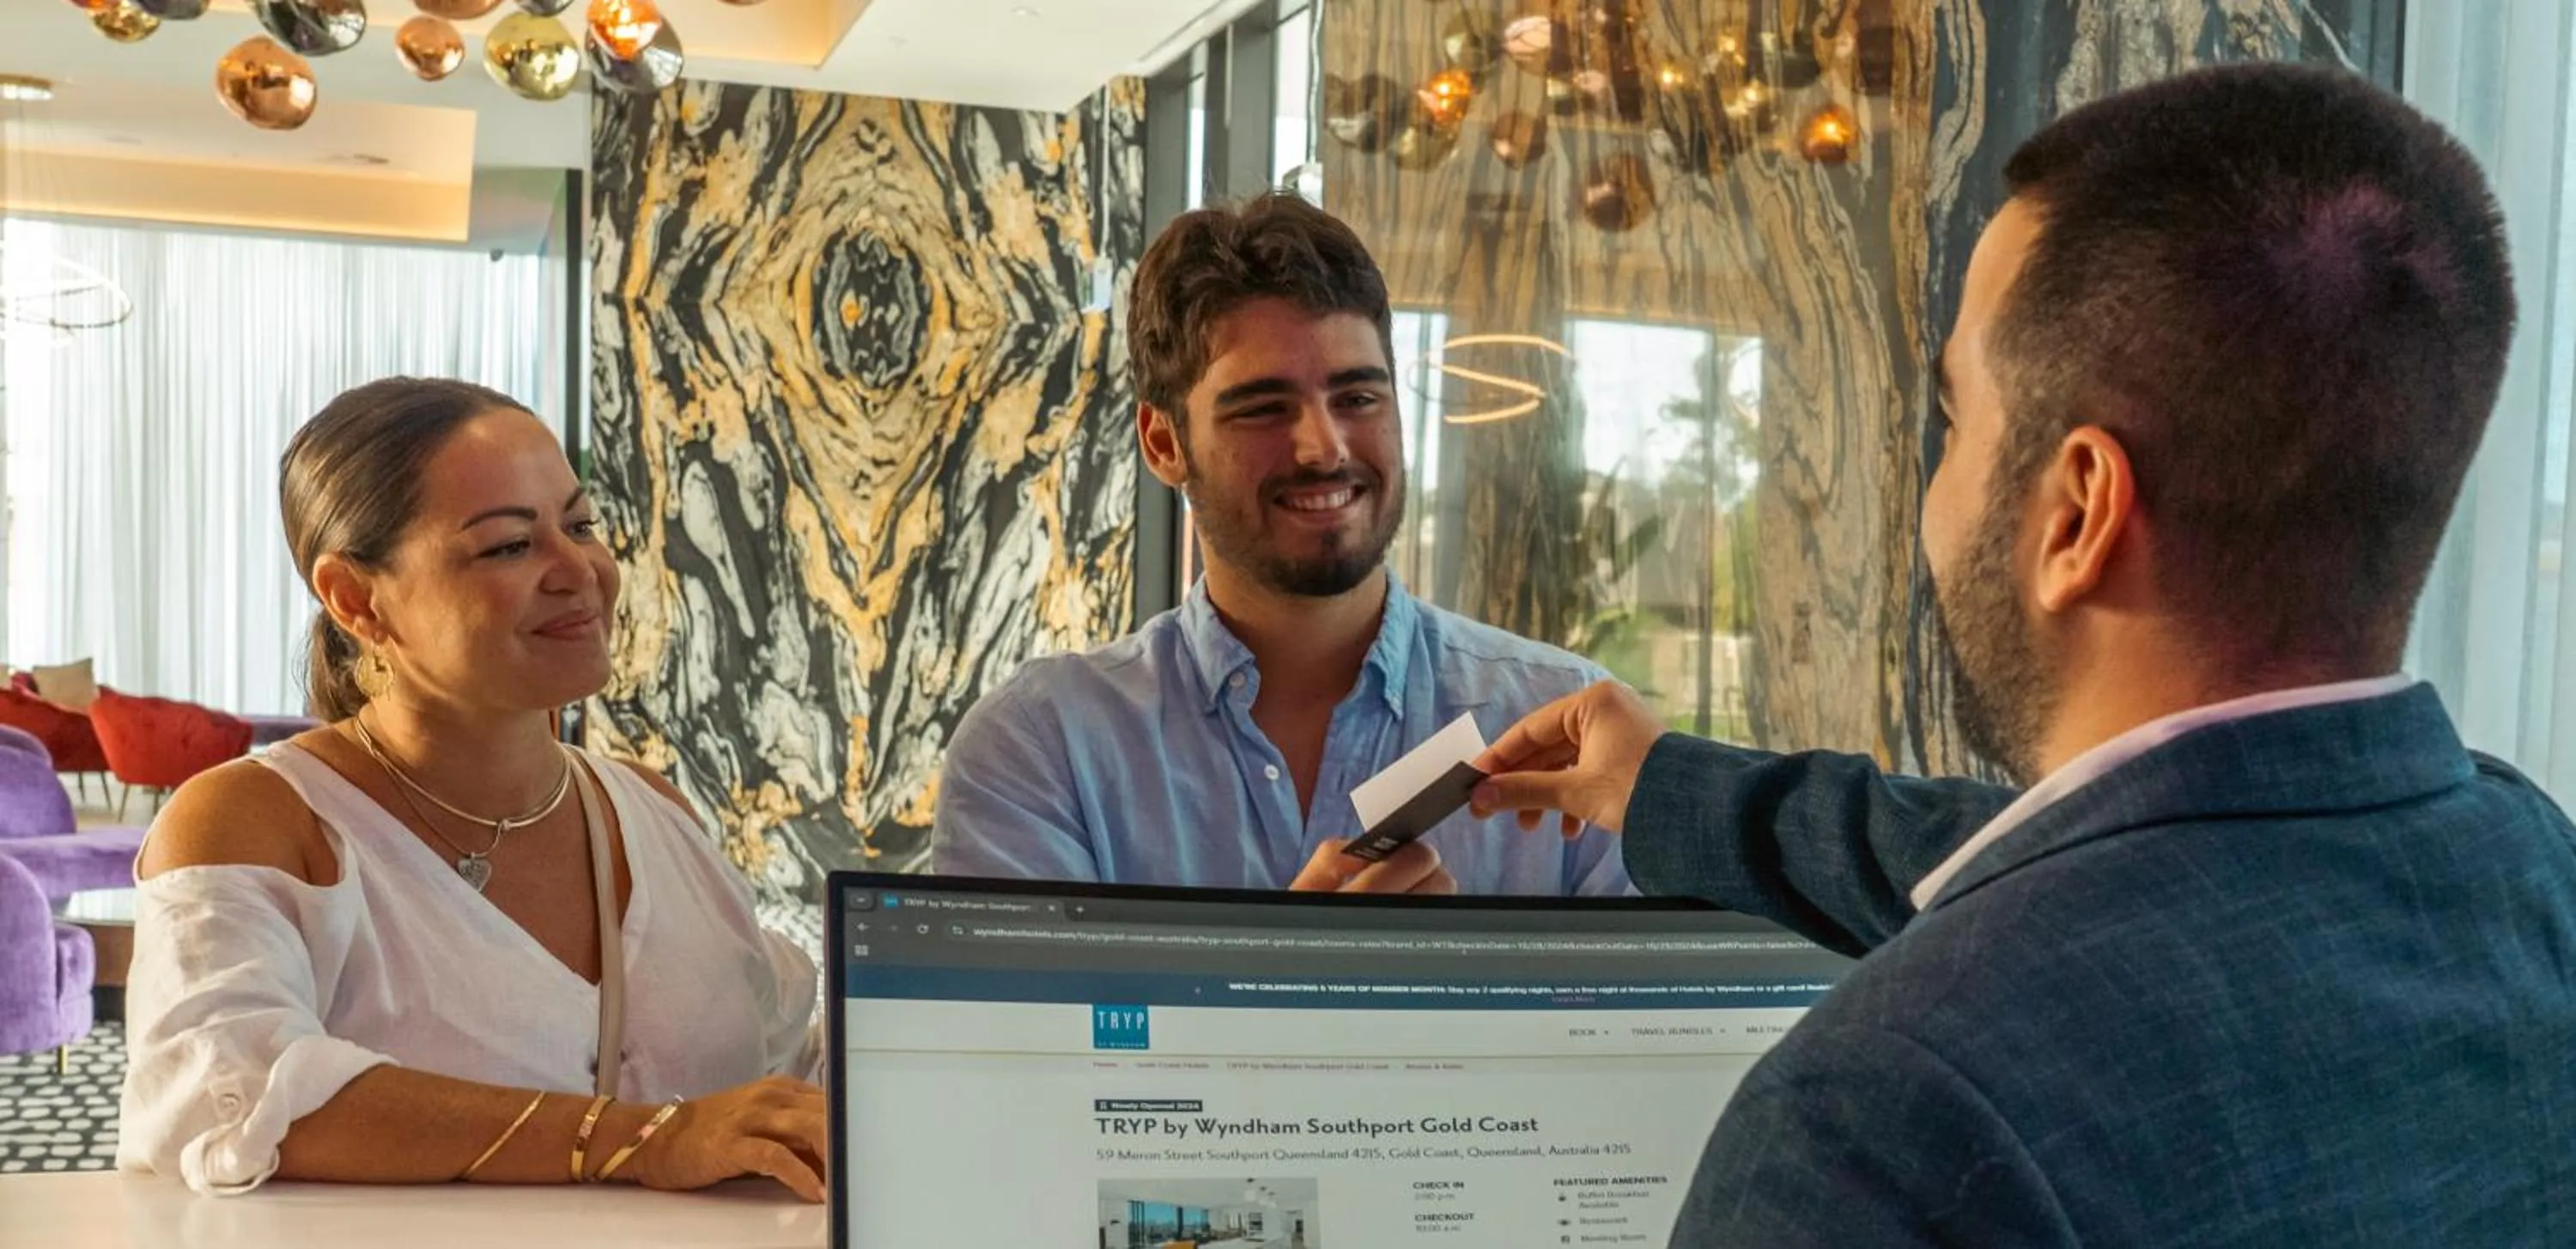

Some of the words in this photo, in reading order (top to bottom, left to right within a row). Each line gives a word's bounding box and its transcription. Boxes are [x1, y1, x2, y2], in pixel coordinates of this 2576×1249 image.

[1097, 1011, 1145, 1030] TRYP
[1095, 1118, 1157, 1135] TRYP
[1164, 1118, 1188, 1138] by
[1194, 1118, 1301, 1139] Wyndham
[1307, 1117, 1414, 1138] Southport
[1419, 1116, 1473, 1134] Gold
[1479, 1117, 1540, 1133] Coast
[1097, 1148, 1115, 1160] 59
[1164, 1148, 1202, 1160] Street
[1206, 1148, 1270, 1163] Southport
[1273, 1148, 1349, 1160] Queensland
[1352, 1148, 1385, 1161] 4215,
[1388, 1147, 1420, 1160] Gold
[1423, 1147, 1464, 1161] Coast,
[1467, 1145, 1546, 1160] Queensland,
[1548, 1144, 1600, 1157] Australia
[1601, 1143, 1631, 1155] 4215
[1413, 1181, 1451, 1190] CHECK
[1452, 1181, 1465, 1190] IN
[1552, 1177, 1609, 1186] FEATURED
[1611, 1175, 1668, 1185] AMENITIES
[1414, 1212, 1474, 1222] CHECKOUT
